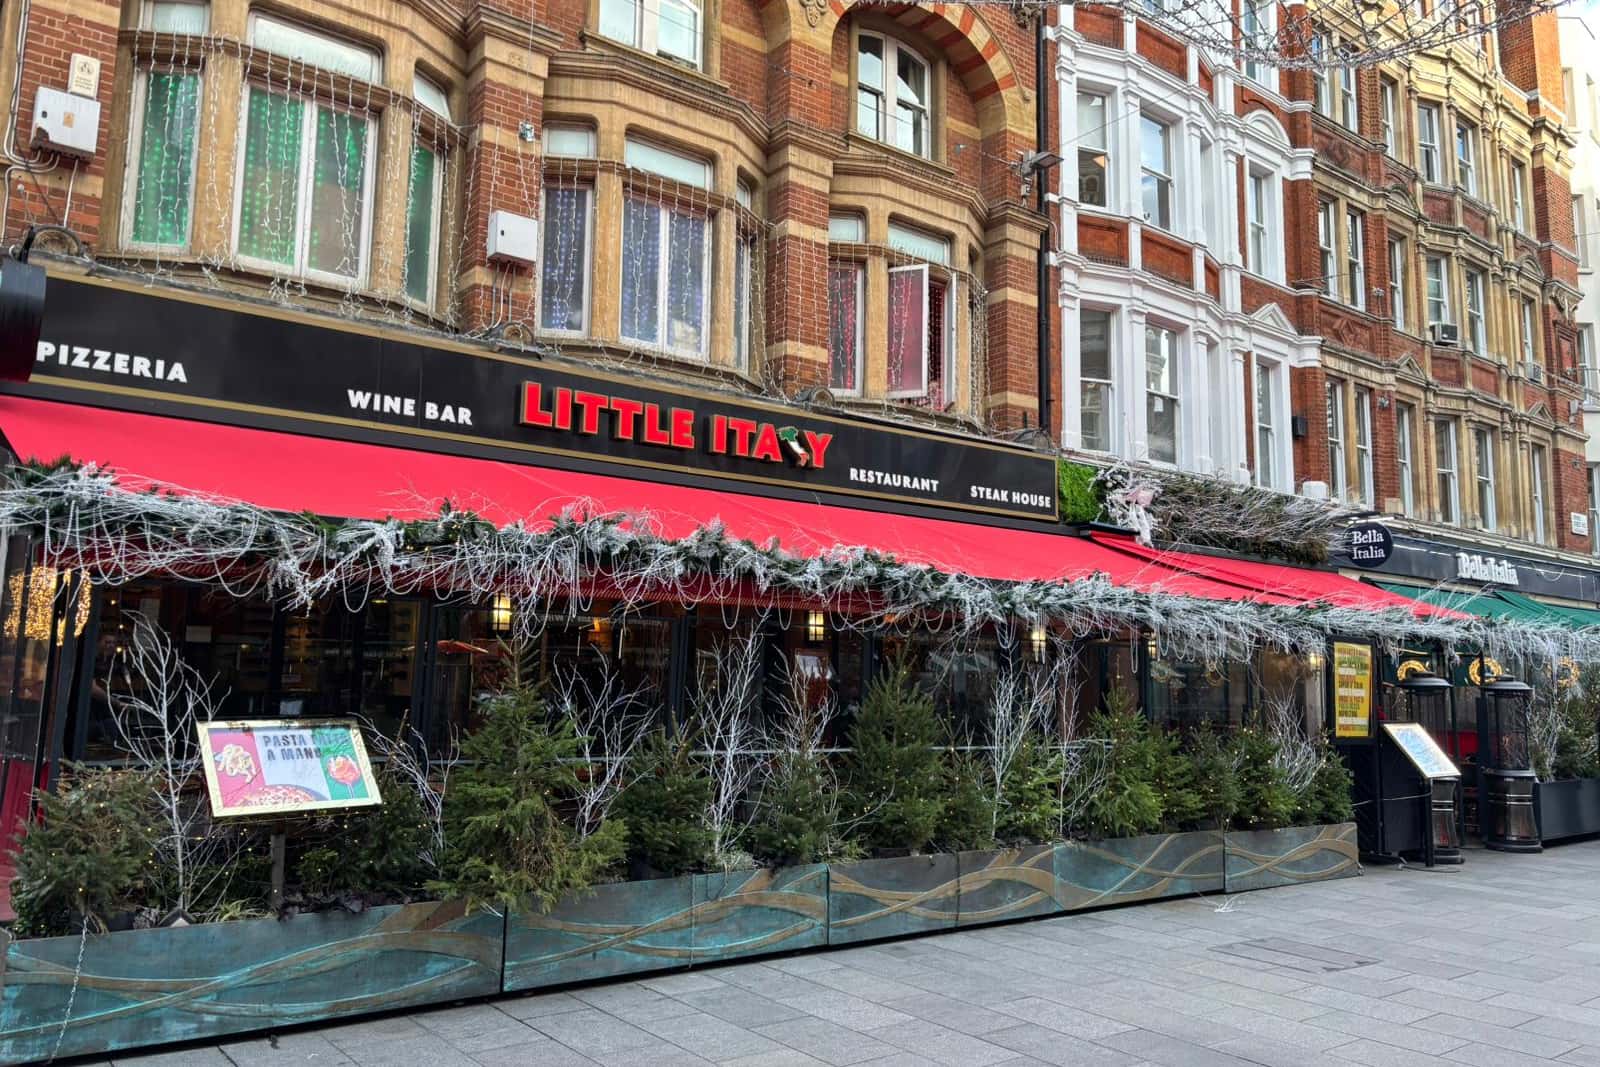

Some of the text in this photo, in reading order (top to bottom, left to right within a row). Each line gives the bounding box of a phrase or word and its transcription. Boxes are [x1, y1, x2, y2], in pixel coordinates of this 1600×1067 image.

[36, 341, 188, 383] PIZZERIA
[347, 389, 473, 426] WINE BAR
[521, 380, 695, 449] LITTLE
[850, 467, 939, 492] RESTAURANT
[970, 485, 1051, 508] STEAK HOUSE
[1351, 529, 1384, 545] Bella
[1352, 545, 1385, 559] Italia
[1456, 552, 1519, 585] Bella Italia
[263, 734, 306, 747] PASTA
[267, 748, 275, 760] A
